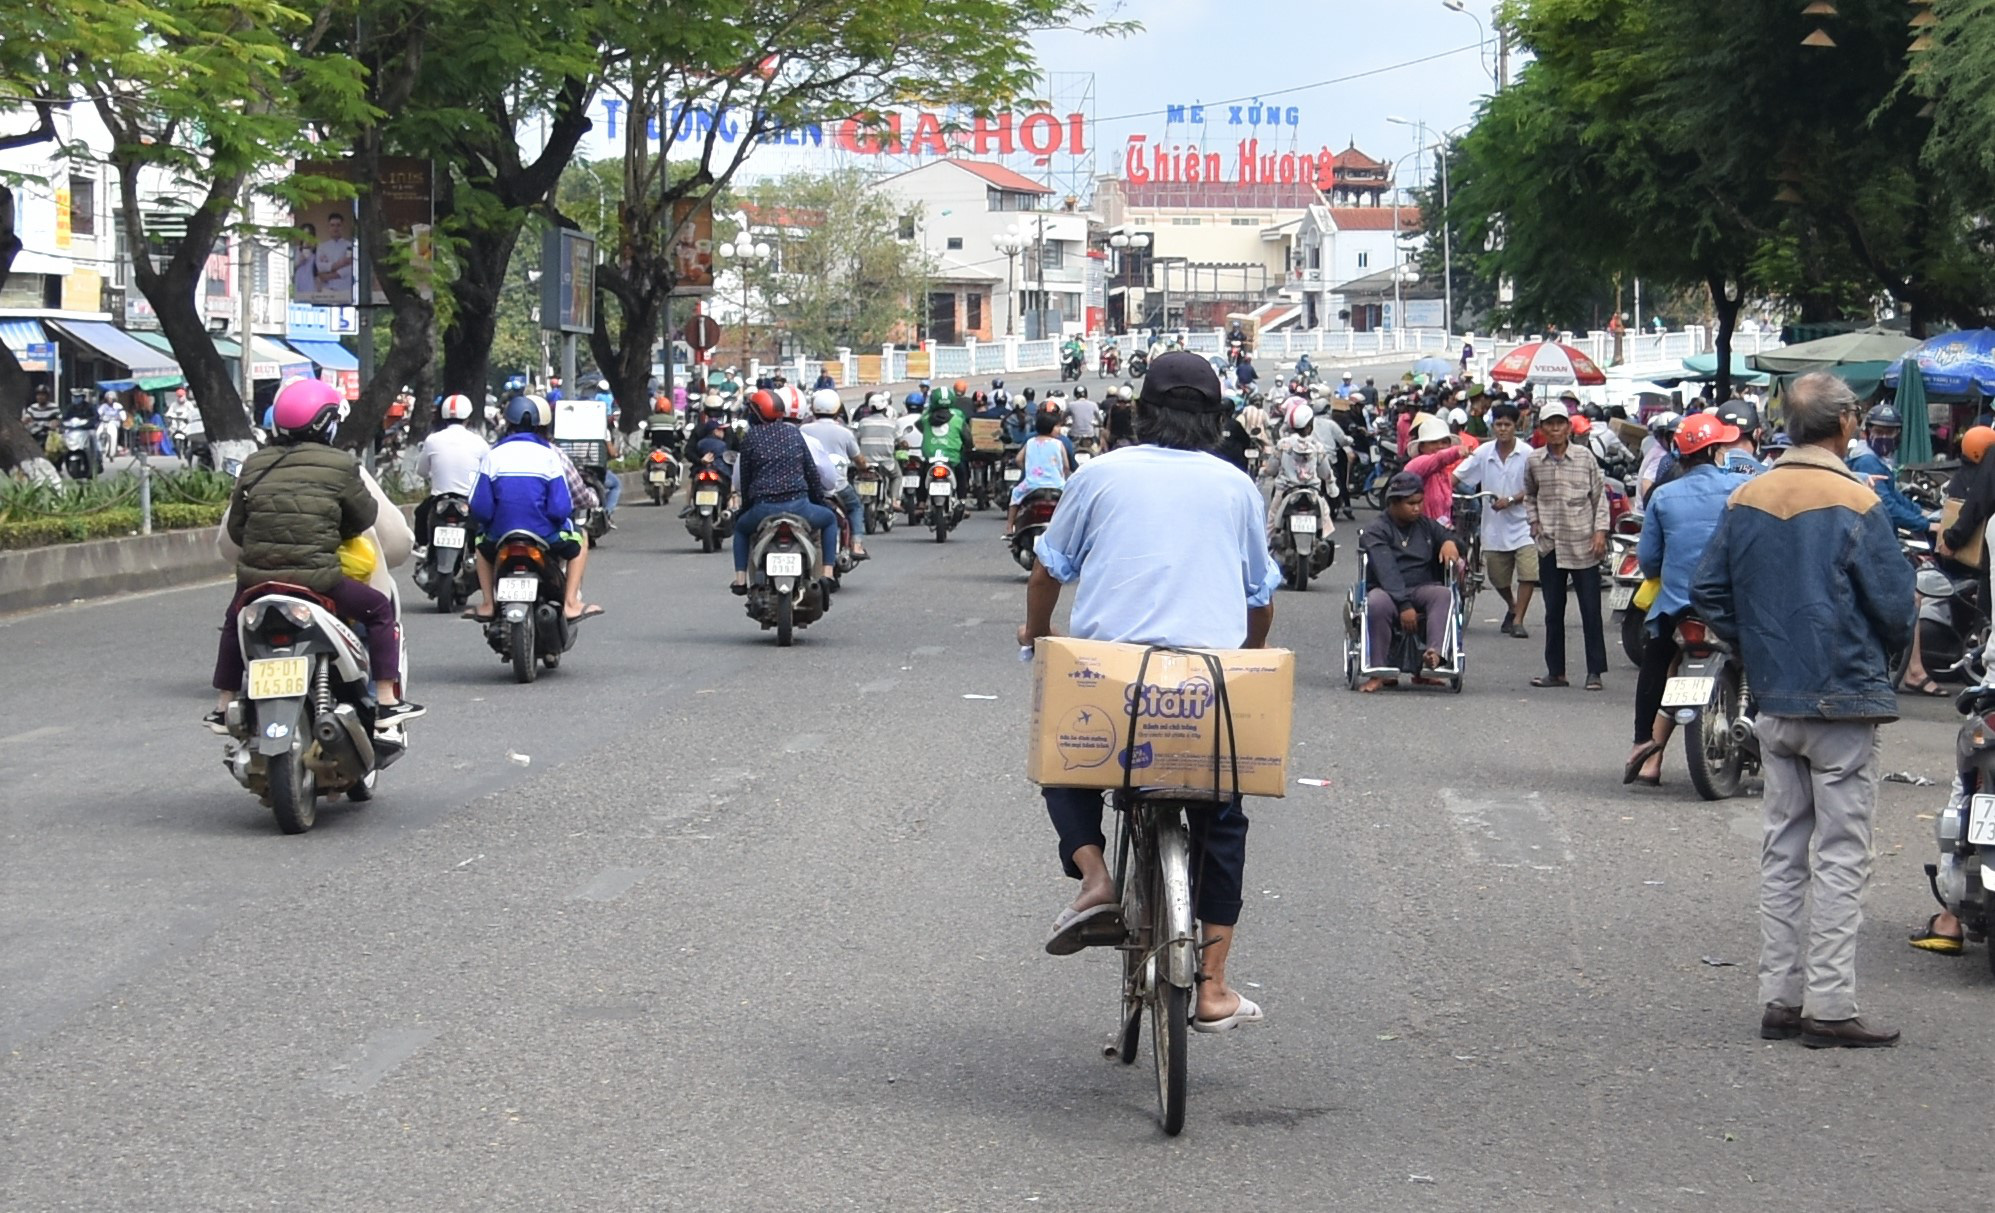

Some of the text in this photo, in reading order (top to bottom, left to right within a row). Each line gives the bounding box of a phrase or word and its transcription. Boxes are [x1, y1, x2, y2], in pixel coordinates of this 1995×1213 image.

[1126, 135, 1221, 185] Thiên
[1534, 365, 1568, 373] VEDAN
[255, 678, 304, 696] 145.86
[1124, 682, 1209, 719] Staff
